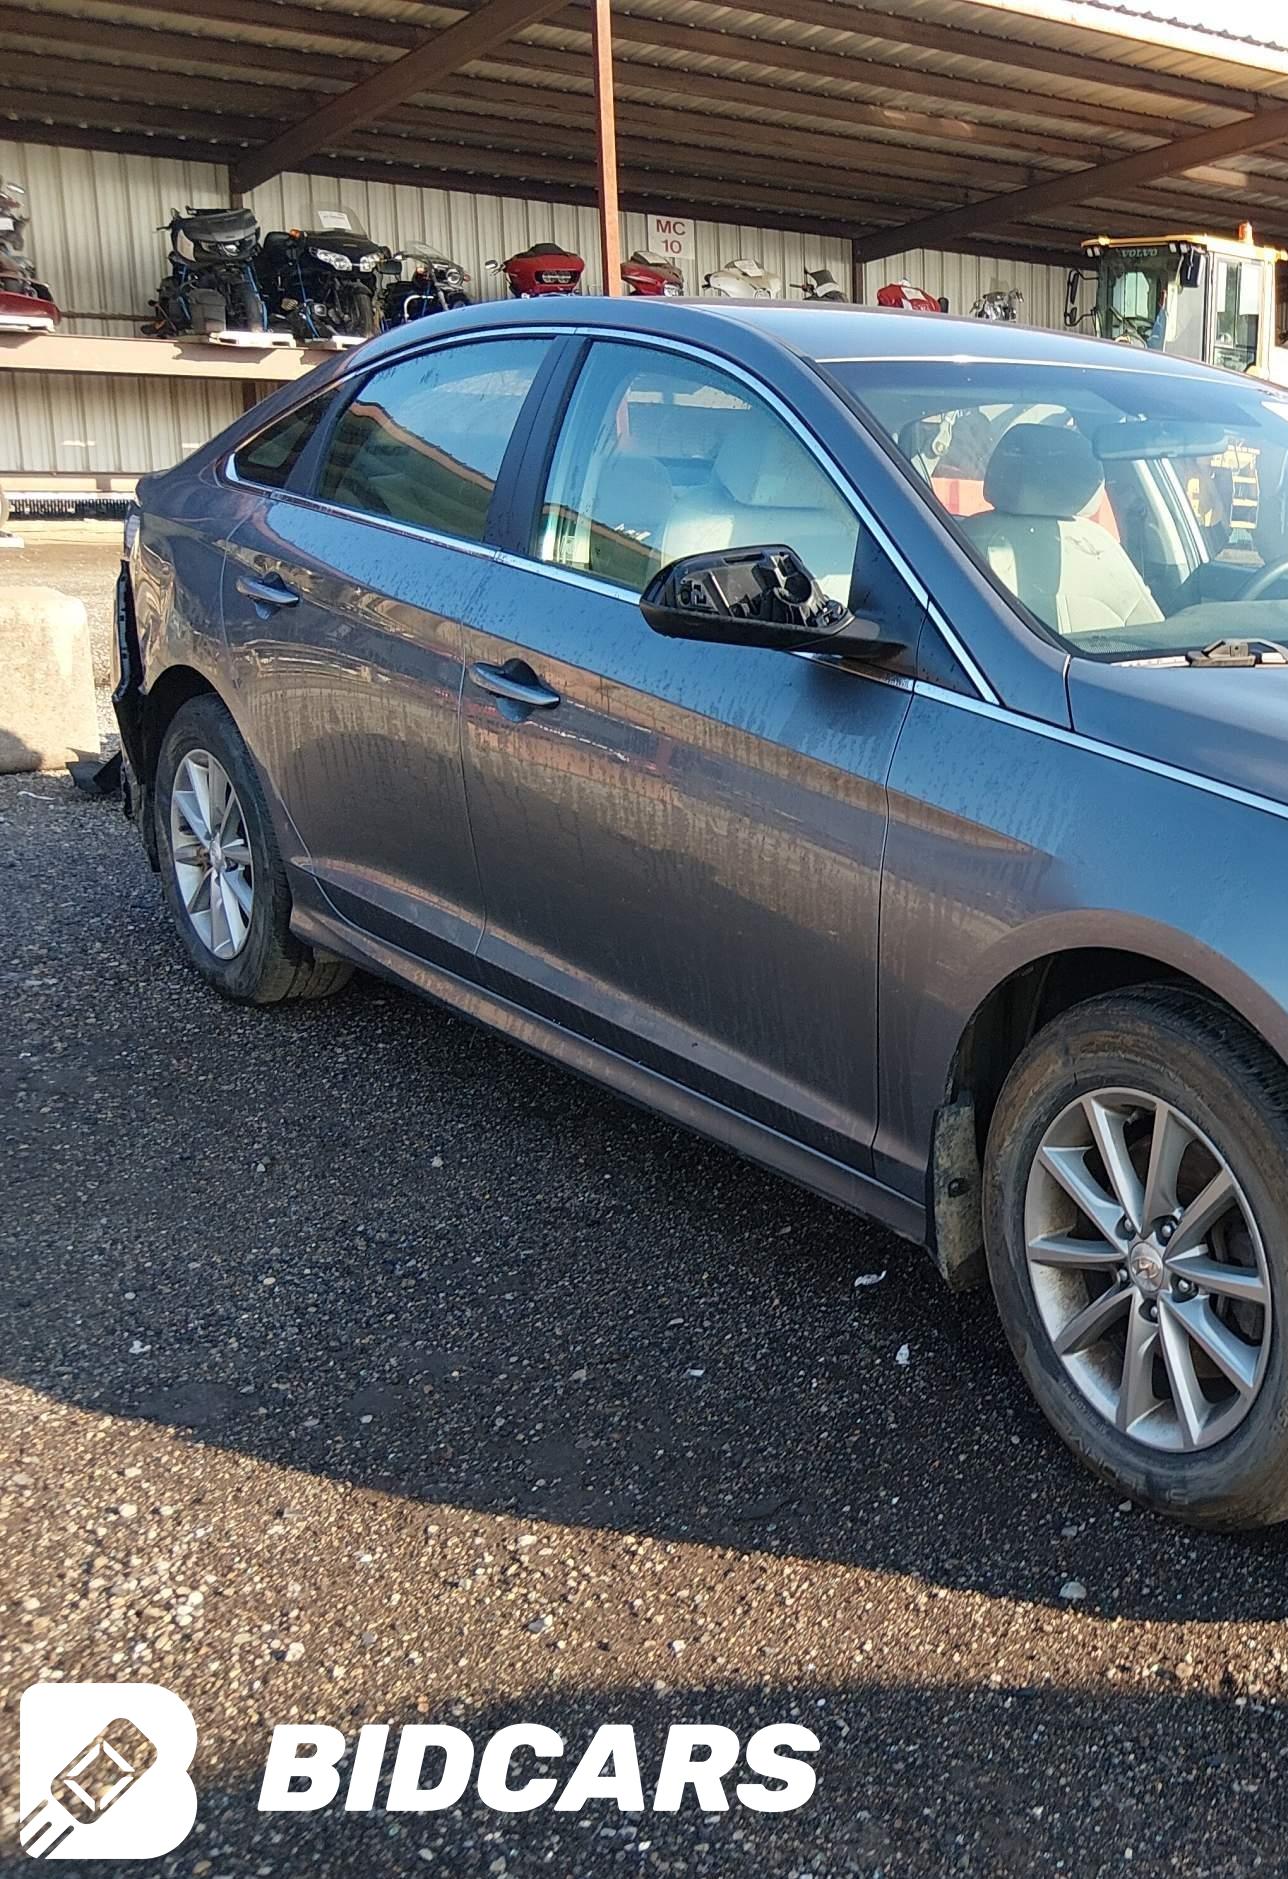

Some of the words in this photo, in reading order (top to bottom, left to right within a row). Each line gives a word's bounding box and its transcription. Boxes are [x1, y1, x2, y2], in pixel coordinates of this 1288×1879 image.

[656, 219, 686, 236] MC
[661, 239, 682, 254] 10
[1121, 248, 1158, 258] VOLVO
